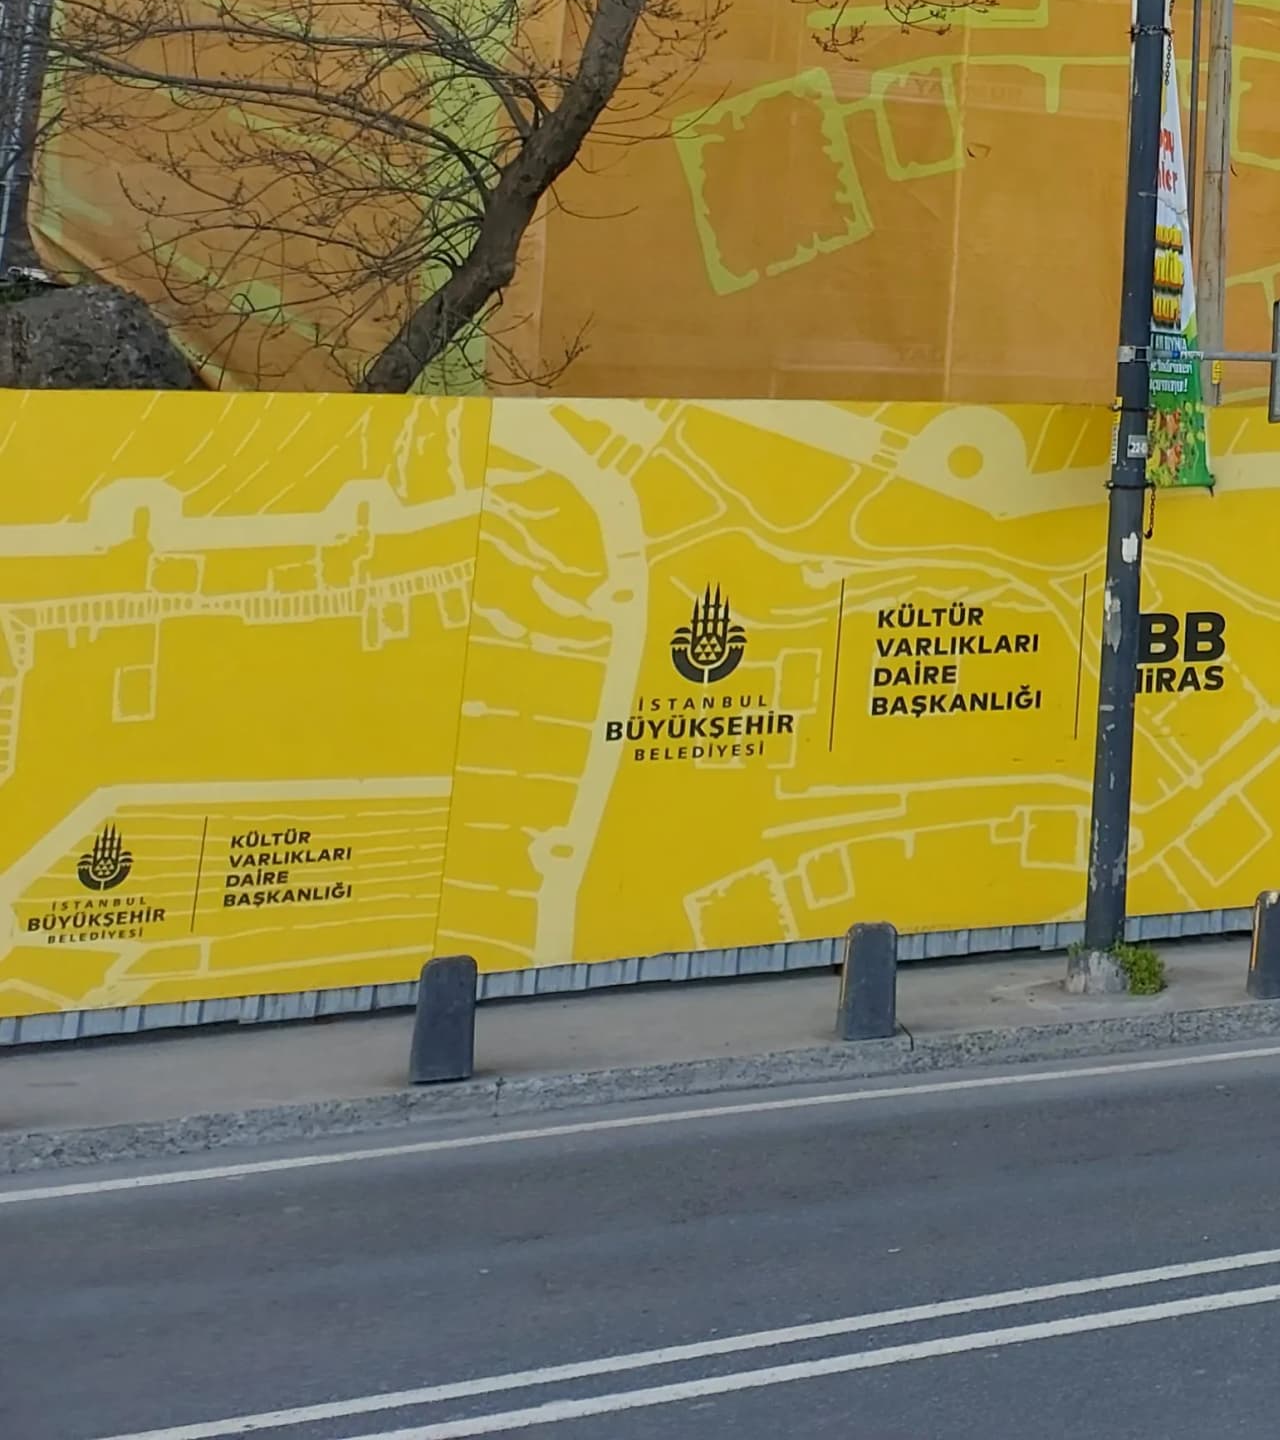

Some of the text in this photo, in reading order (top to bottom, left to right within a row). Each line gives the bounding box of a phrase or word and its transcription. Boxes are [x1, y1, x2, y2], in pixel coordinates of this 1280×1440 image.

[877, 602, 985, 629] KÜLTÜR
[876, 634, 1039, 658] VARLIKLARI
[1138, 611, 1226, 664] BB
[873, 661, 958, 687] DAİRE
[638, 695, 768, 712] İSTANBUL
[871, 685, 1042, 718] BAŞKANLIĞI
[605, 711, 795, 742] BÜYÜKŞEHİR
[634, 740, 765, 762] BELEDİYESİ
[230, 828, 312, 849] KÜLTÜR
[228, 846, 352, 869] VARLIKLARI
[225, 868, 289, 888] DAİRE
[51, 896, 148, 912] İSTANBUL
[223, 881, 353, 908] BAŞKANLIĞI
[27, 906, 166, 932] BÜYÜKŞEHİR
[47, 926, 144, 944] BELEDİYESİ
